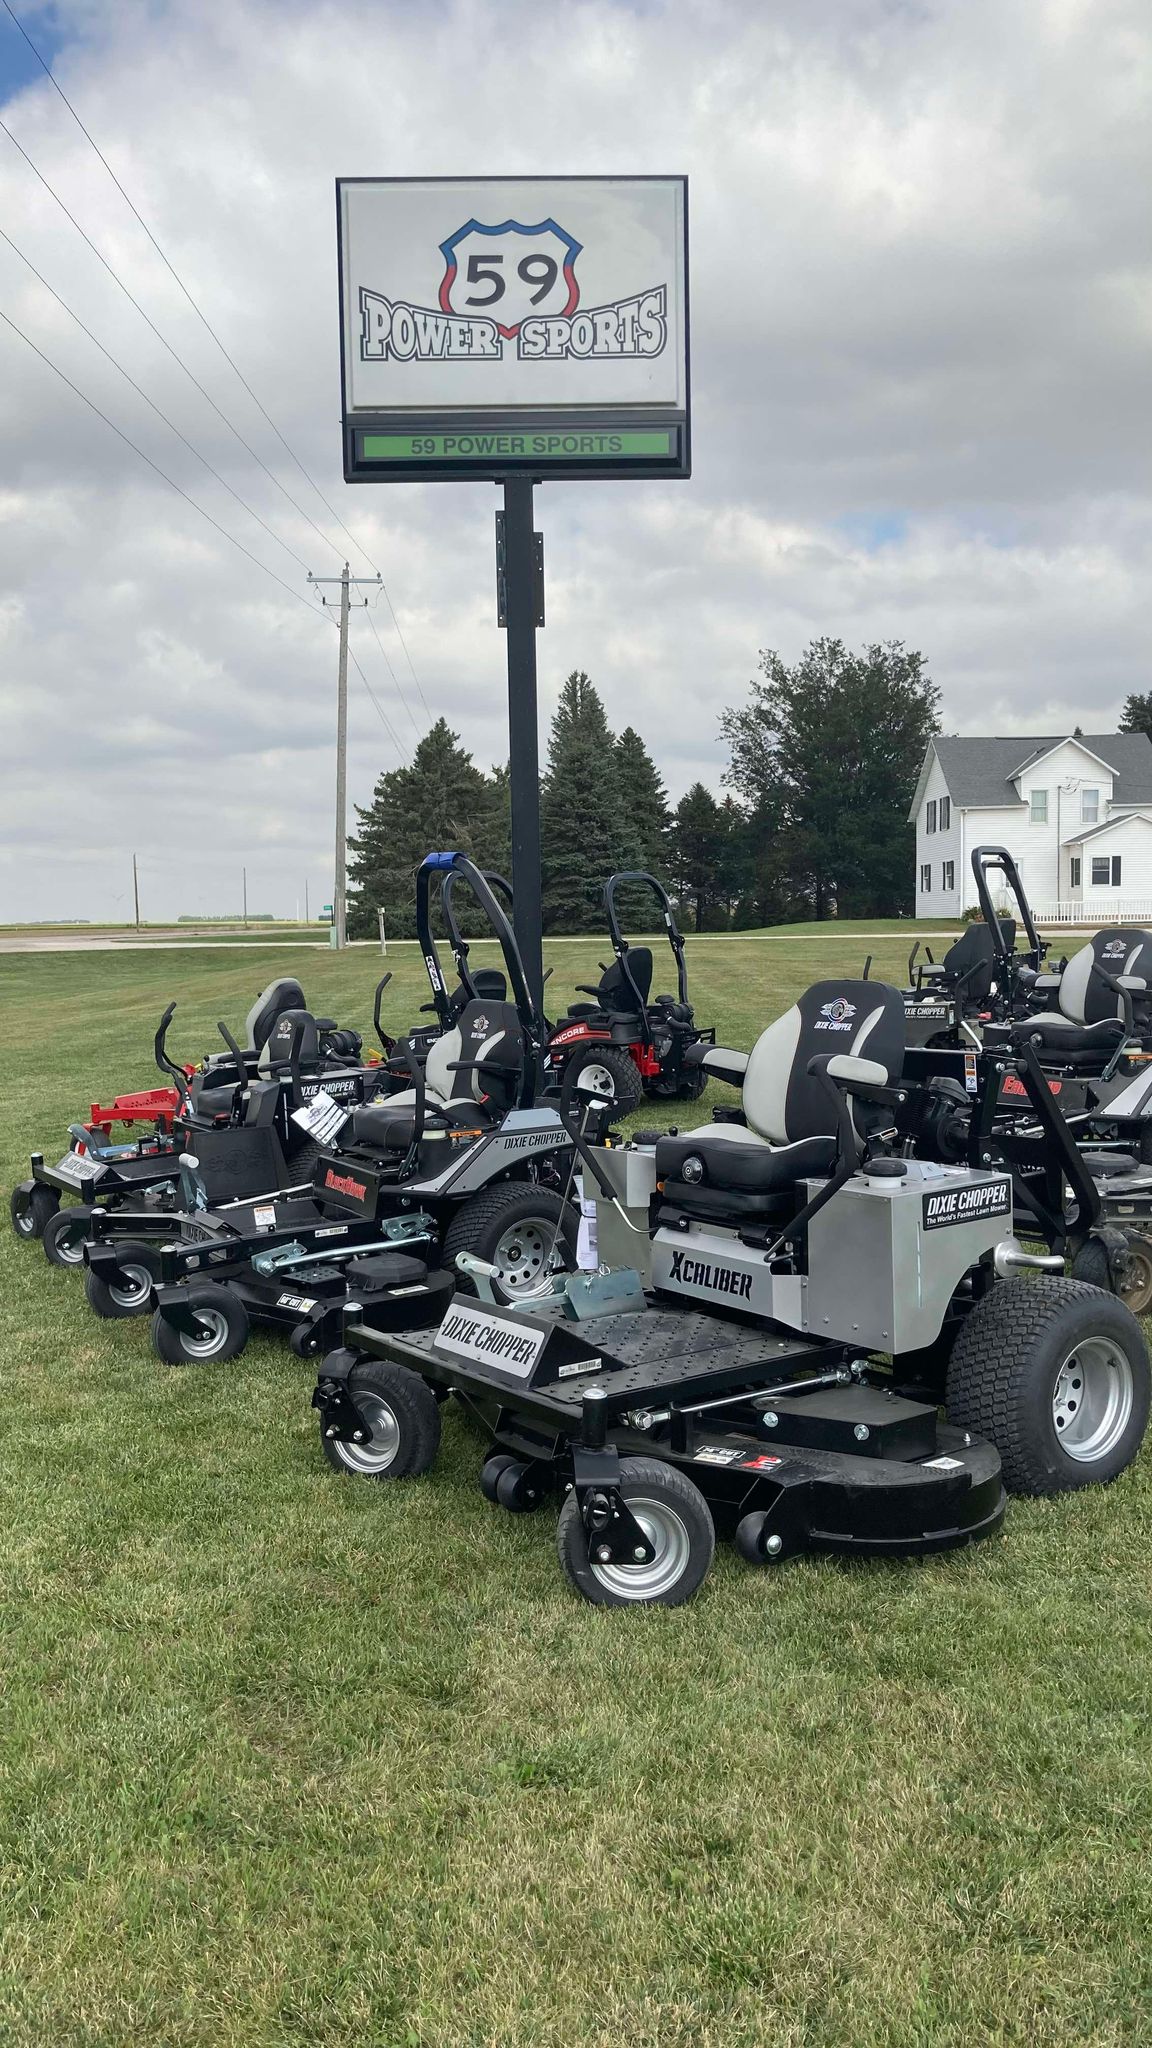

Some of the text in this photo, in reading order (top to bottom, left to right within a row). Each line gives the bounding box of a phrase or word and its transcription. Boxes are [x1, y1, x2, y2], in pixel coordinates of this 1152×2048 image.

[464, 253, 559, 307] 59
[359, 283, 667, 362] POWER SPORTS
[410, 435, 624, 455] 59 POWER SPORTS
[904, 1007, 946, 1016] IXIE CHOPPER
[550, 1027, 585, 1045] ENCORE
[300, 1084, 320, 1097] IXIE
[319, 1080, 355, 1095] CHOPPER
[503, 1131, 568, 1150] DIXIE CHOPPER
[927, 1184, 1007, 1216] DIXIE CHOPPER
[926, 1217, 937, 1225] The
[937, 1213, 957, 1223] World's
[957, 1209, 976, 1219] Fastest
[976, 1207, 990, 1215] Lawn
[669, 1250, 753, 1302] XCALIBER
[441, 1315, 537, 1365] DIXIE CHOPPER
